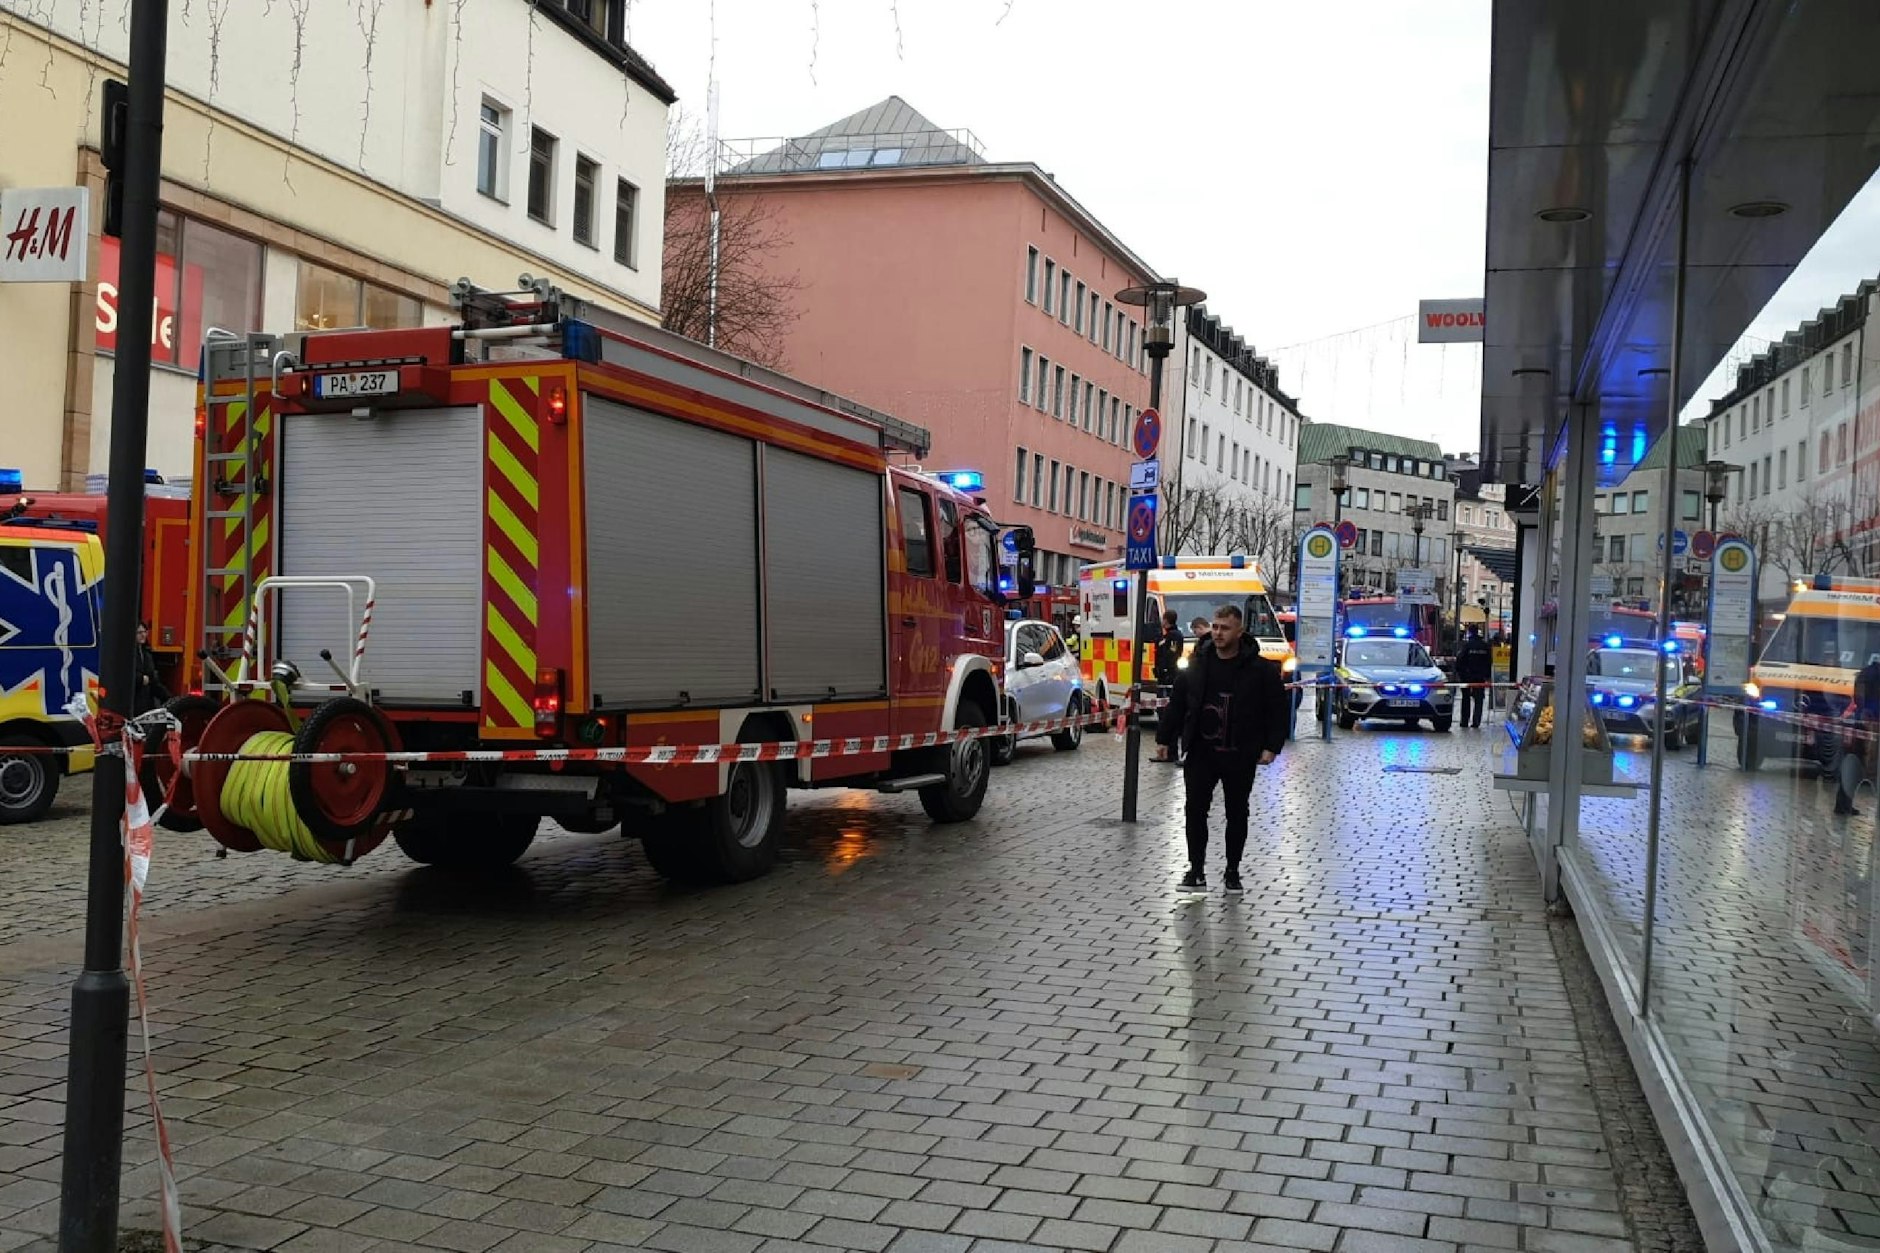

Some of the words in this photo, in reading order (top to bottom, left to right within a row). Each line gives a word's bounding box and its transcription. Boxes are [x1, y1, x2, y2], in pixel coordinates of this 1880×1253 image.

[6, 206, 76, 263] H&M
[96, 282, 173, 349] Sle
[330, 376, 348, 393] PA
[360, 374, 386, 391] 237
[1128, 547, 1152, 564] TAXI
